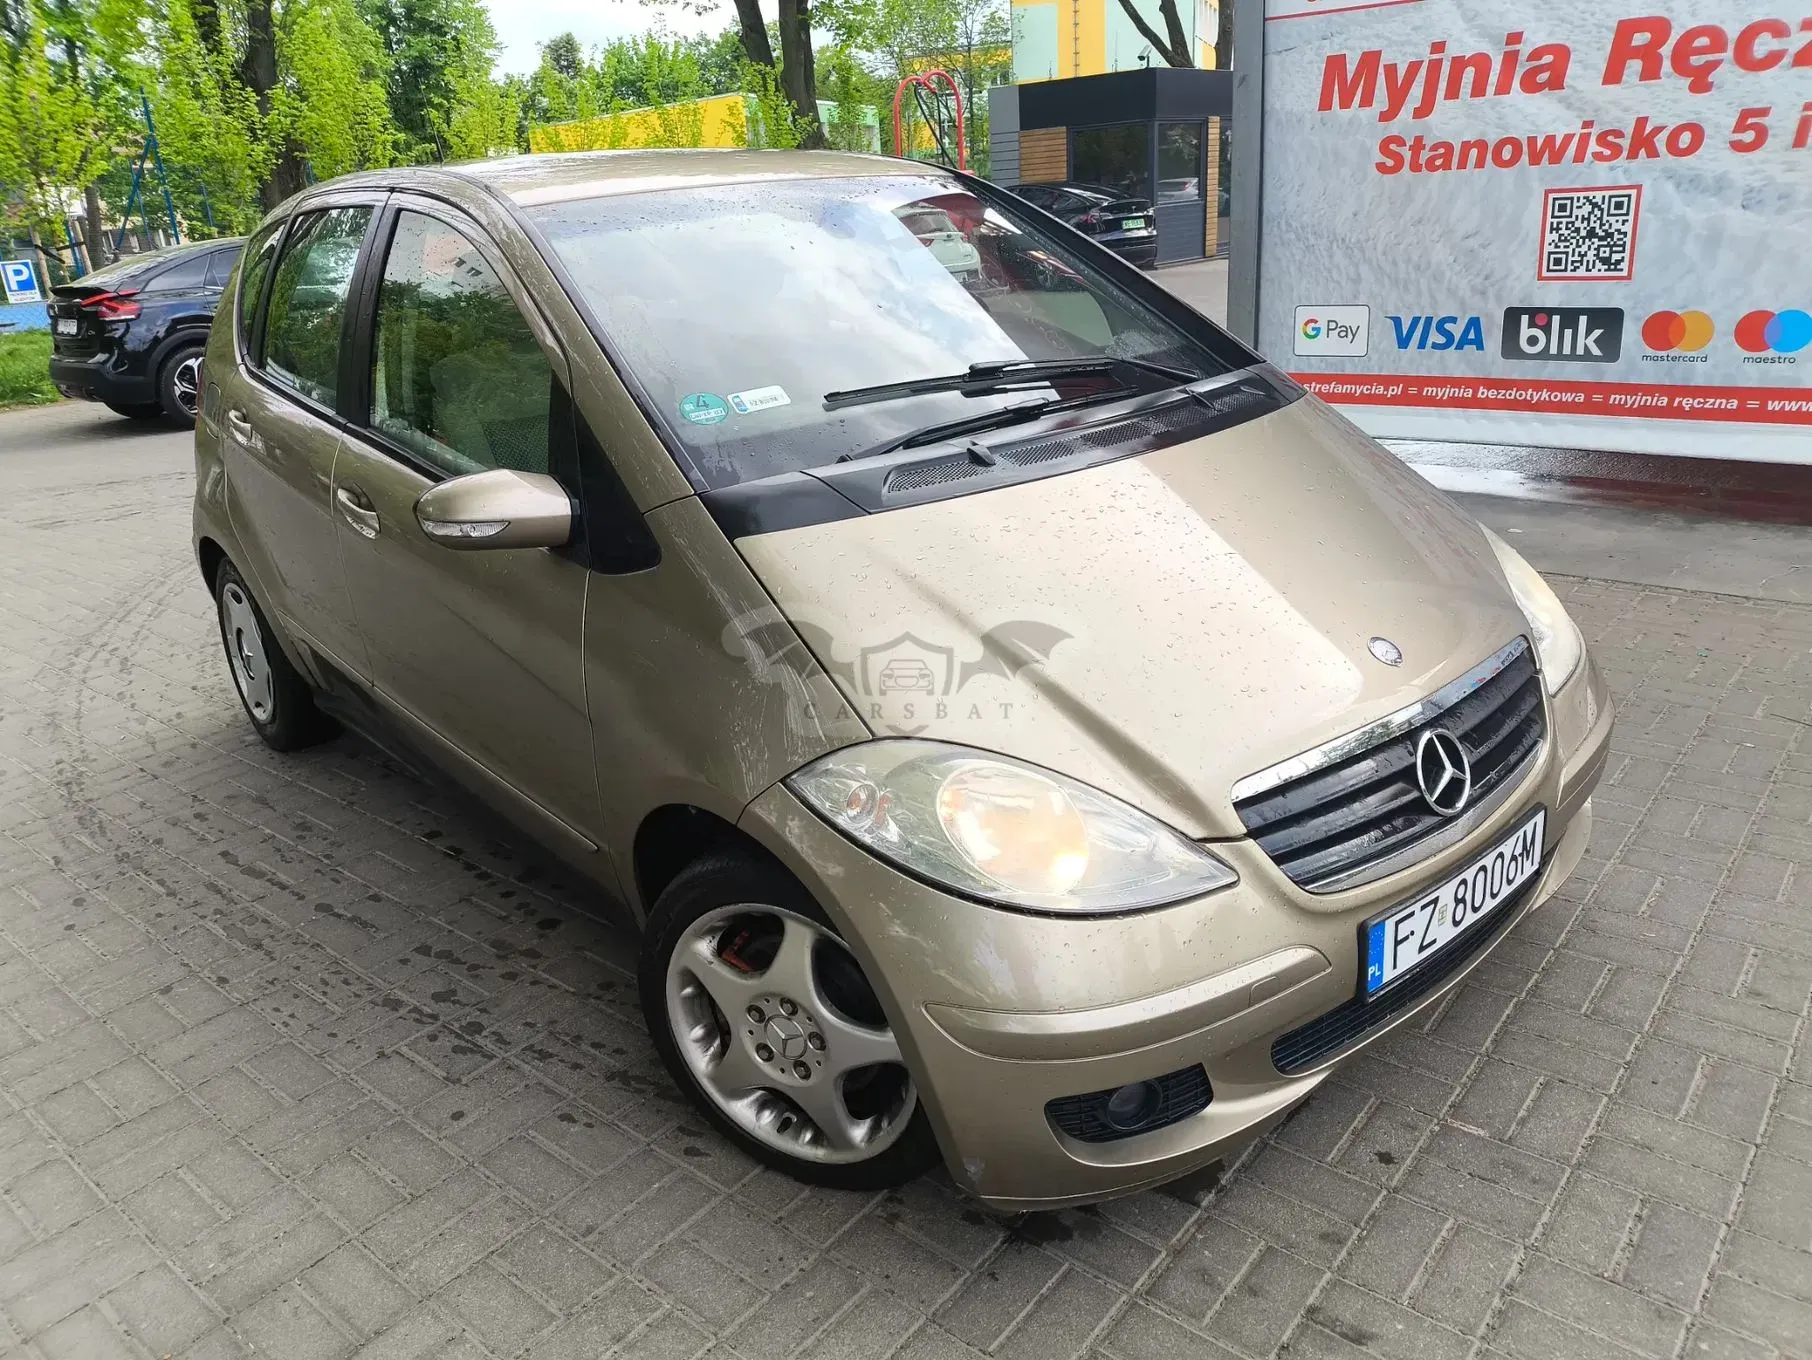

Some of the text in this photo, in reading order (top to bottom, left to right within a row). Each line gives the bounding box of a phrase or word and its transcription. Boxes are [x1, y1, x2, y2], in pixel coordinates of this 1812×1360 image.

[1317, 30, 1572, 123] Myjnia
[1375, 115, 1706, 175] Stanowisko
[1728, 106, 1772, 153] 5
[5, 263, 30, 291] P
[1326, 319, 1361, 344] Pay
[1384, 315, 1485, 351] VISA
[1519, 313, 1605, 356] blik
[1641, 353, 1708, 364] mastercard
[1742, 355, 1797, 365] maestro
[1423, 385, 1472, 400] myjnia
[1477, 386, 1585, 404] bezdotykowa
[1609, 391, 1669, 408] myjnia
[1673, 395, 1739, 411] ręczna
[1392, 821, 1538, 971] FZ 8006M
[1367, 963, 1382, 981] PL
